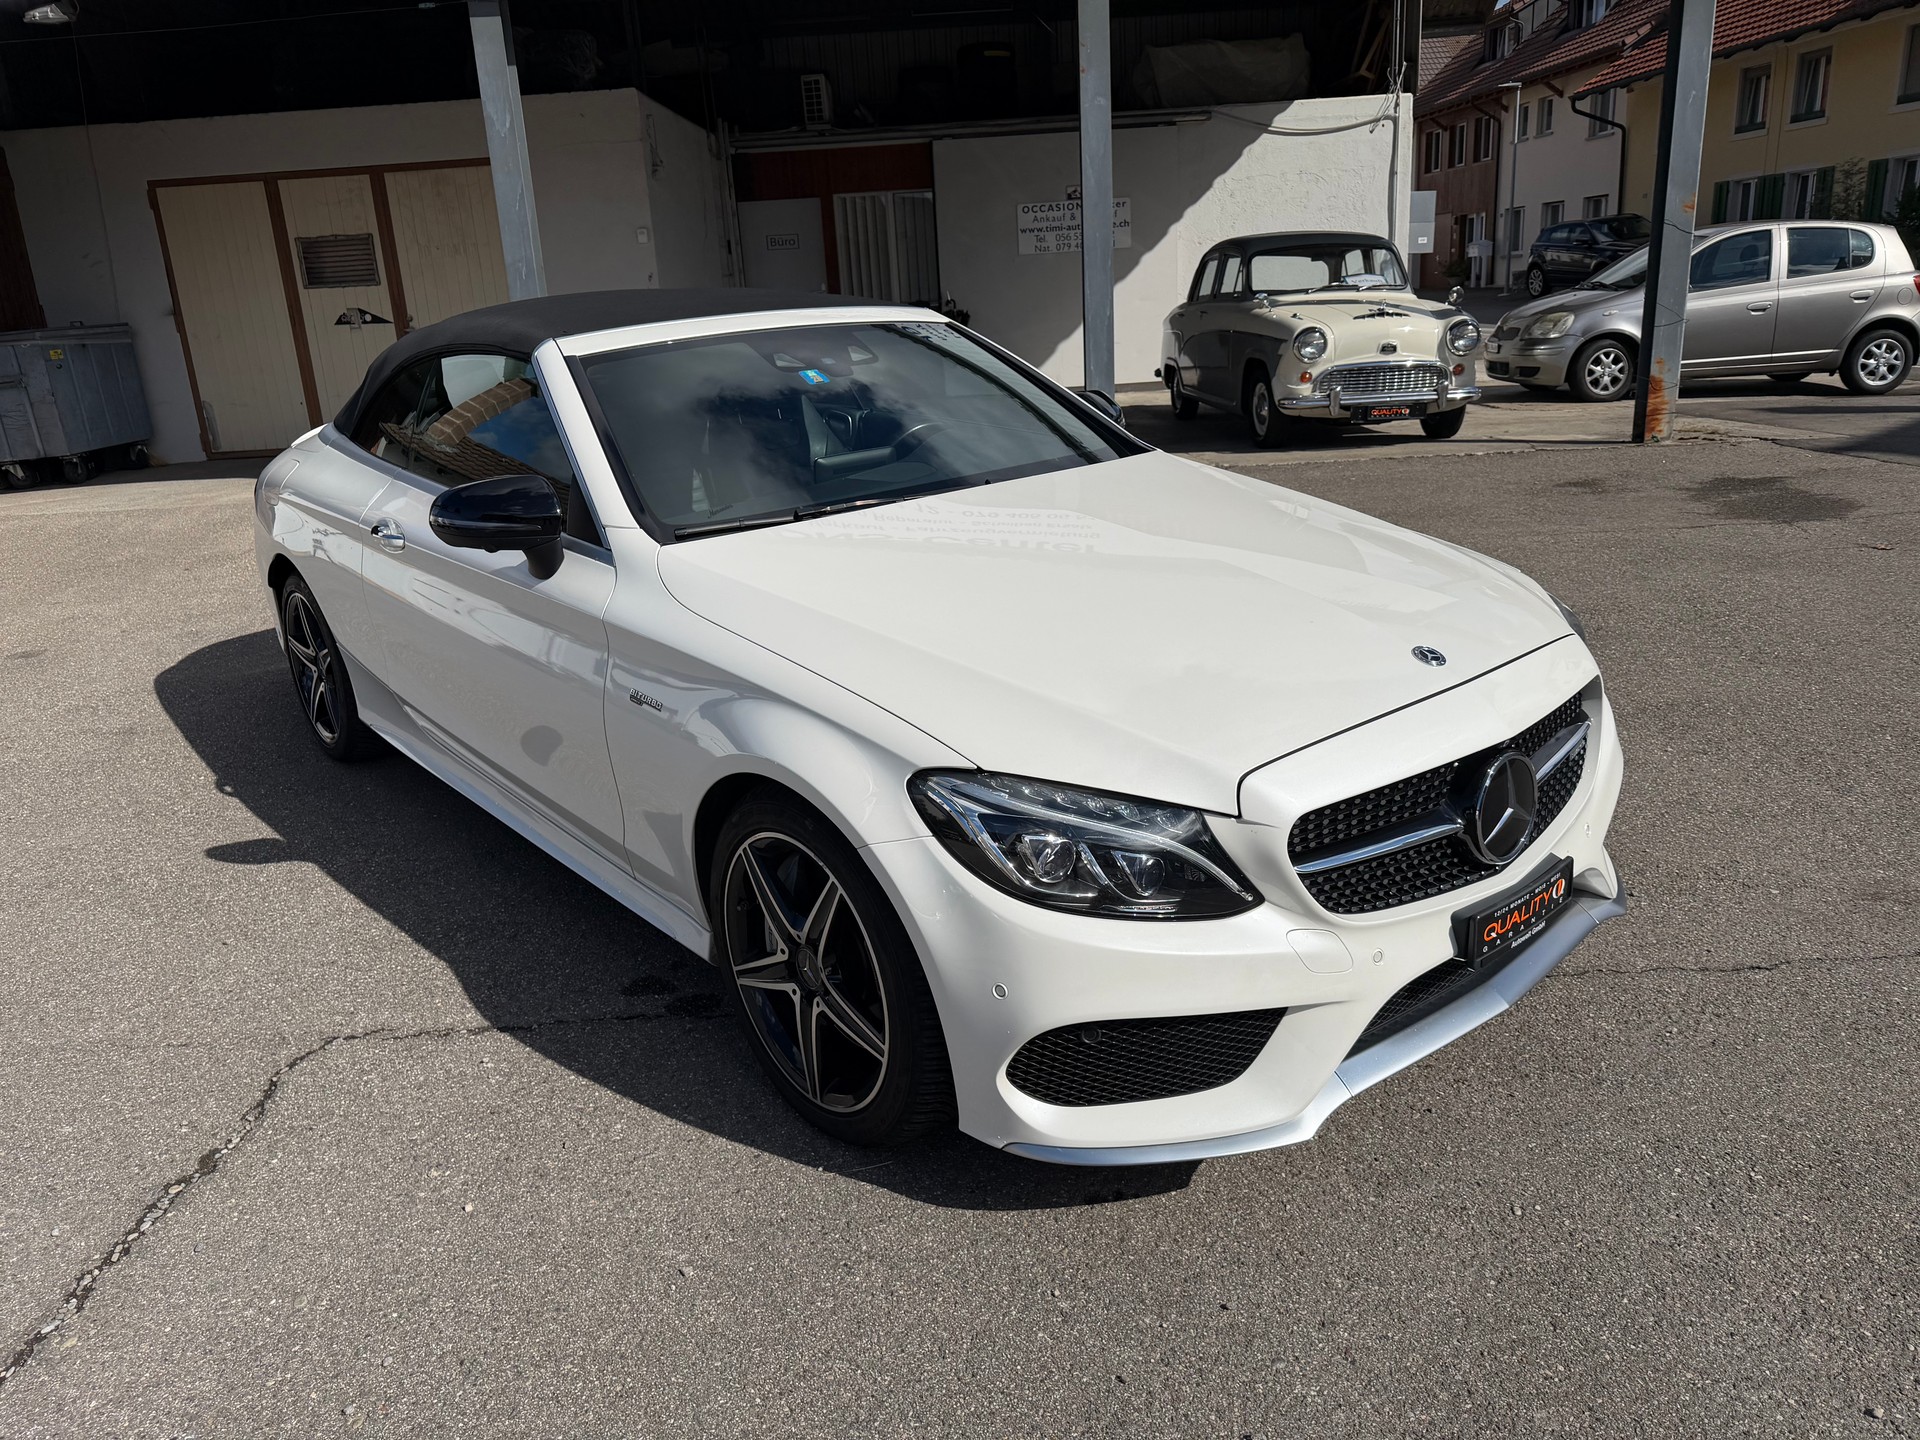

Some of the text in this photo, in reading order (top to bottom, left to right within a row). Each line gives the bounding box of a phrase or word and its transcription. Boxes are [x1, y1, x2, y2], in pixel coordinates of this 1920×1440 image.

[1032, 212, 1076, 223] Ankauf &
[770, 237, 796, 247] Büro
[1034, 234, 1048, 243] Tel.
[1055, 233, 1072, 242] 056
[1034, 244, 1053, 252] Nat.
[1055, 242, 1072, 251] 079
[630, 688, 663, 711] BITURBO
[1510, 893, 1530, 909] MONATE
[1483, 886, 1553, 942] QUALITY
[1532, 920, 1546, 935] GmbH
